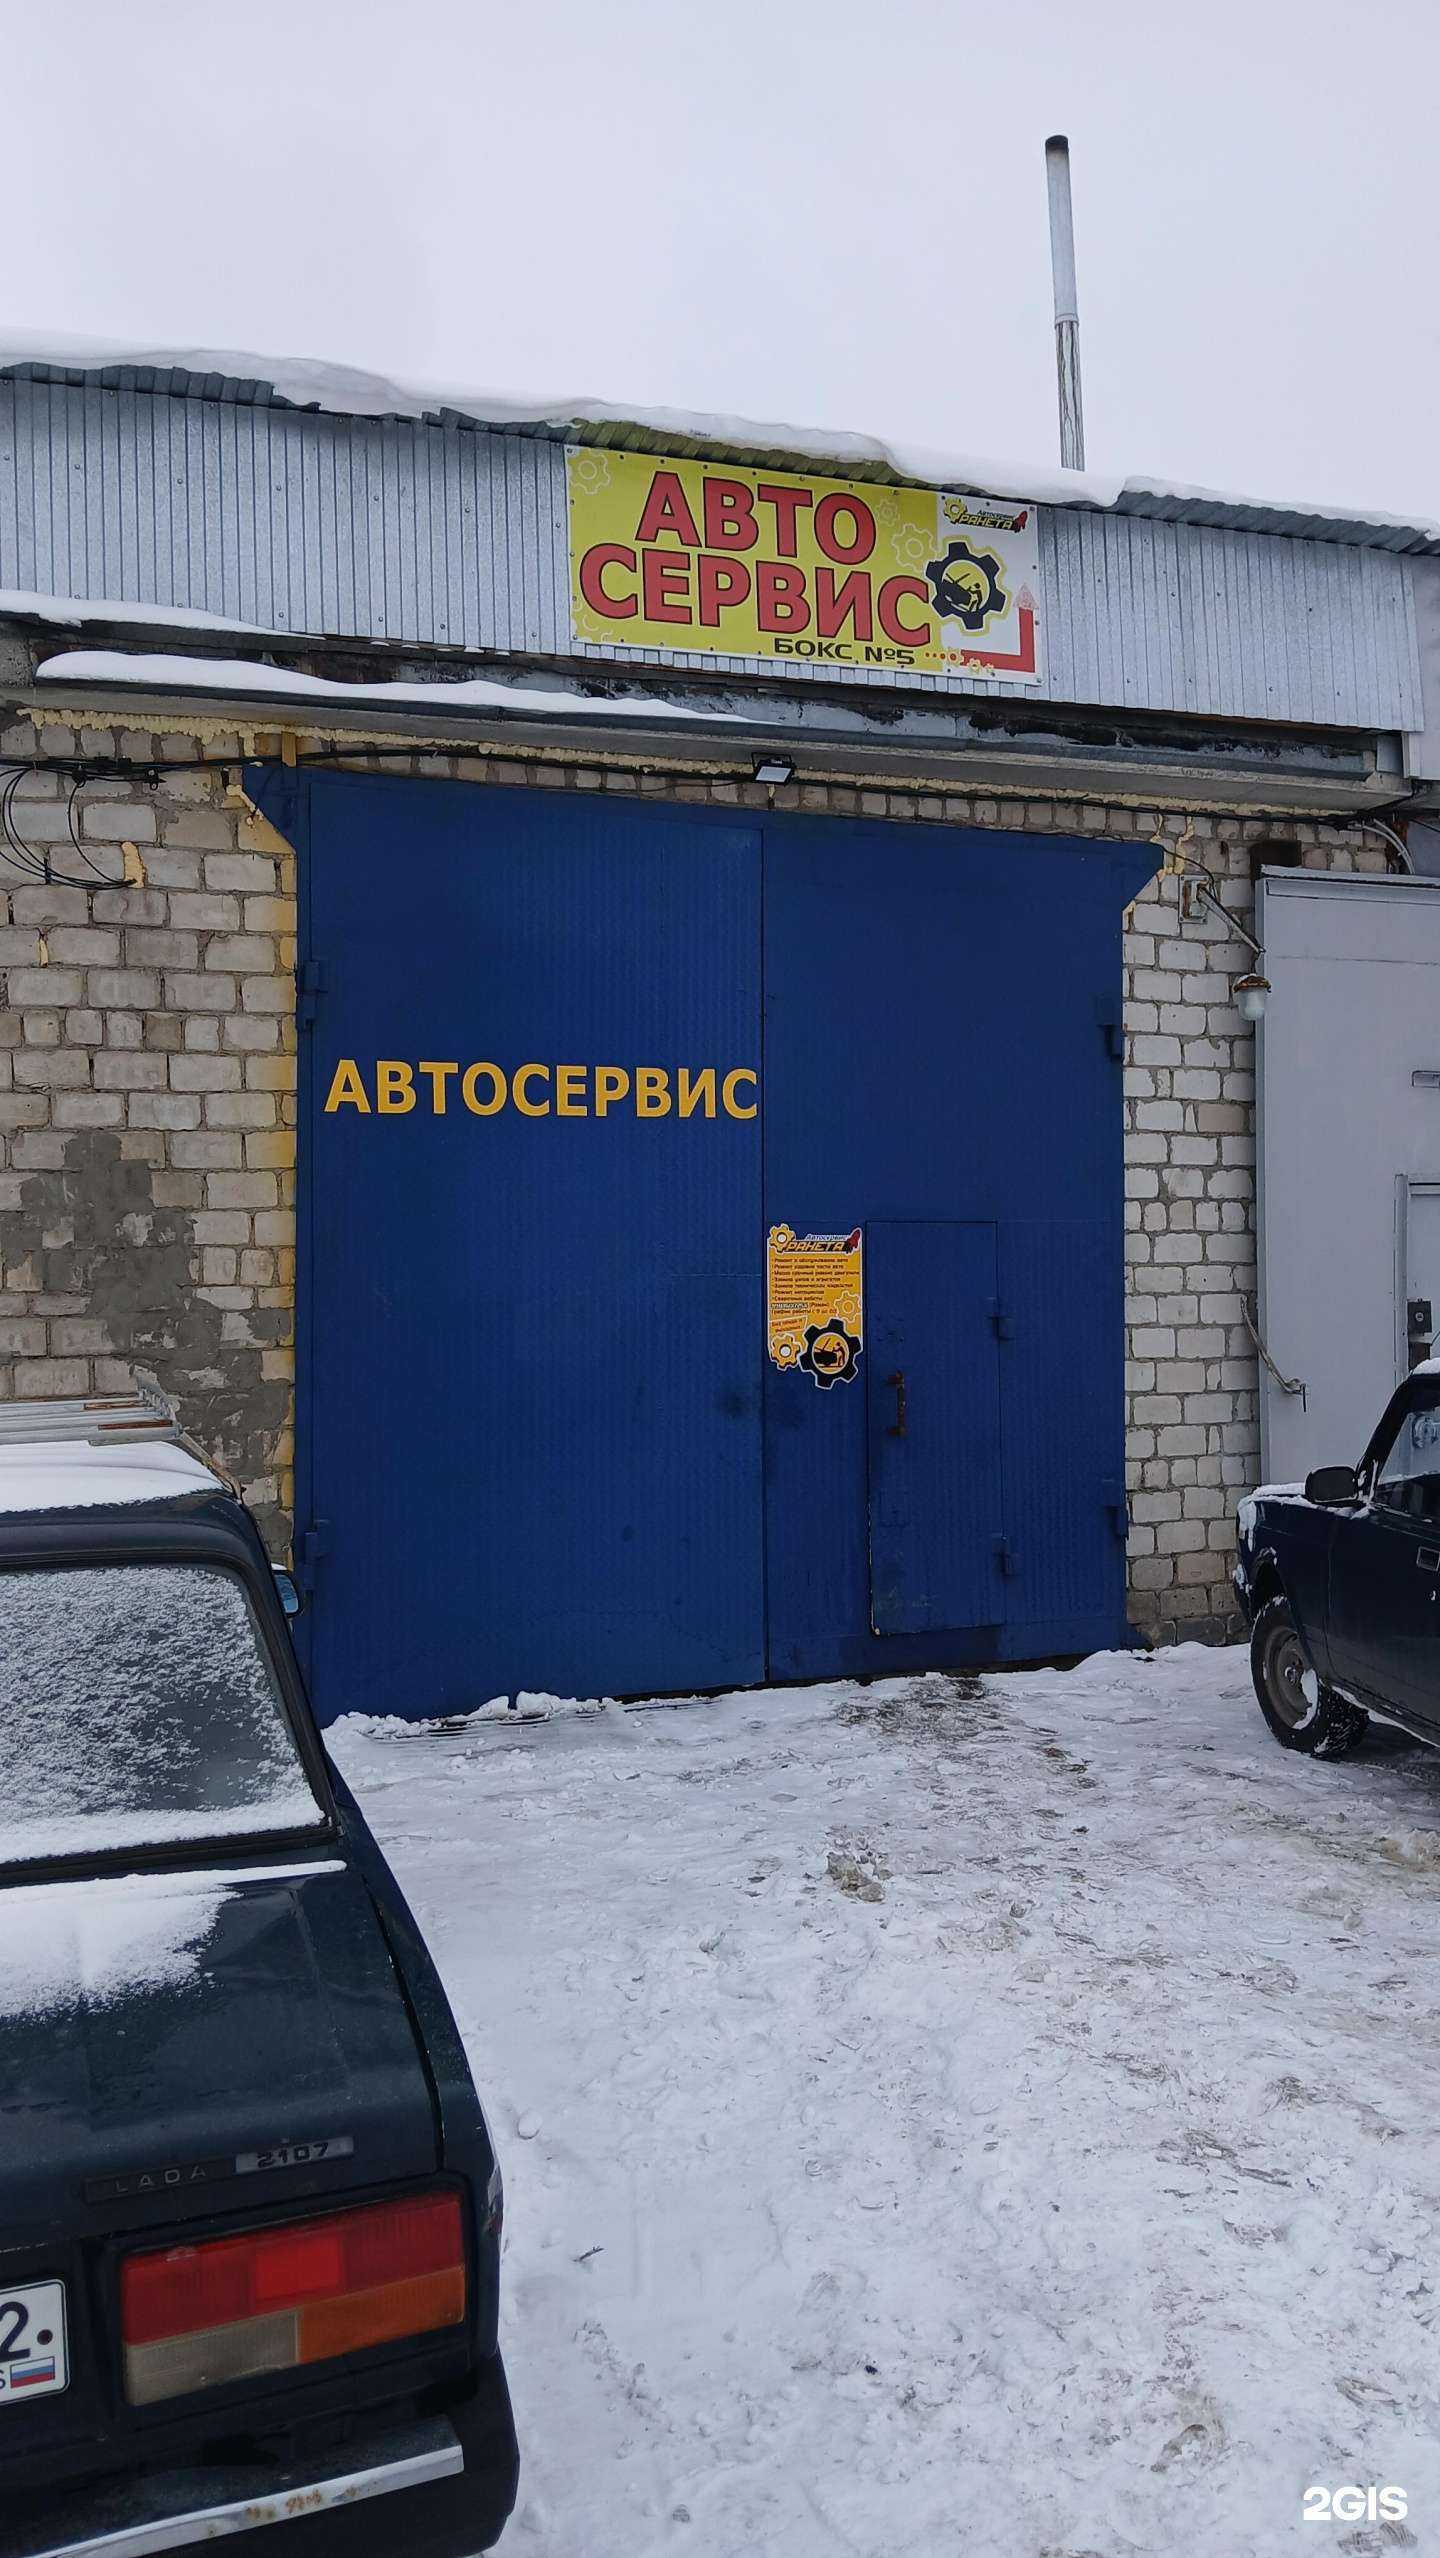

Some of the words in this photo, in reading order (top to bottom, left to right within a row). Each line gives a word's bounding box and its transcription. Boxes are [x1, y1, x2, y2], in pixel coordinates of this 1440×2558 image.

[635, 471, 877, 566] АВТО
[579, 543, 931, 647] СЕРВИС
[774, 638, 852, 660] БОКС
[865, 646, 915, 665] №5
[323, 1059, 759, 1120] АВТОСЕРВИС
[257, 2142, 329, 2169] 2107
[115, 2164, 206, 2193] LADA
